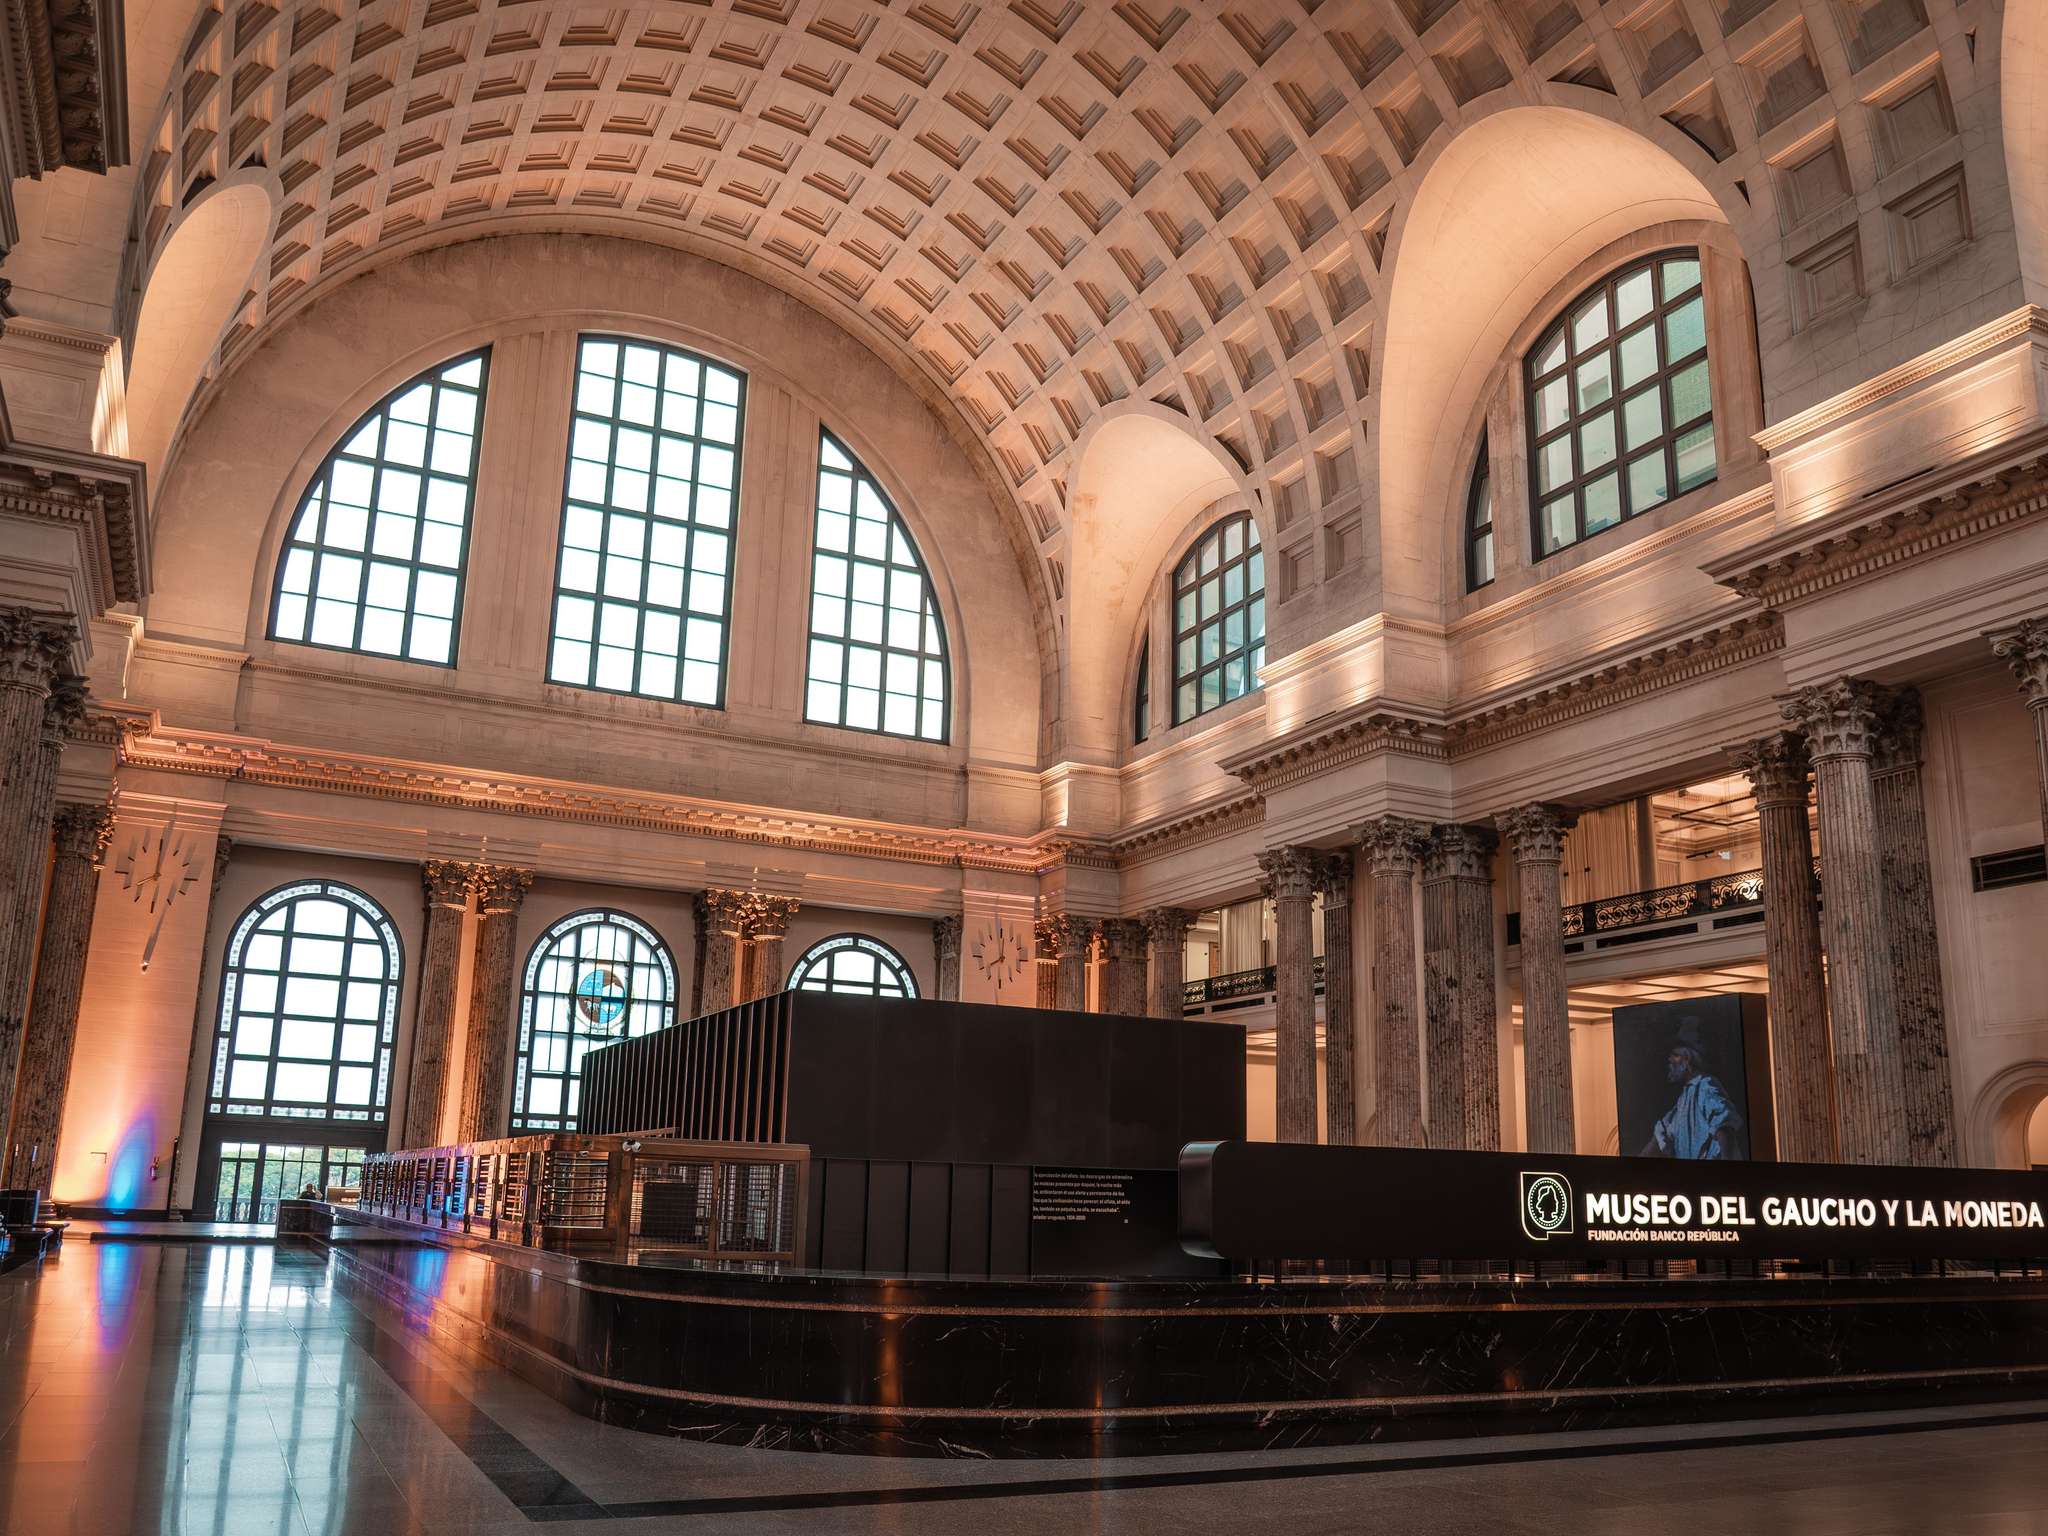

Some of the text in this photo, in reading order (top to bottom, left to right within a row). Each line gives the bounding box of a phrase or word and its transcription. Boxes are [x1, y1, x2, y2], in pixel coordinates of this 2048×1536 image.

[1585, 1192, 2045, 1228] MUSEO DEL GAUCHO Y LA MONEDA
[1587, 1228, 1740, 1242] FUNDACIÓN BANCO REPÚBLICA
